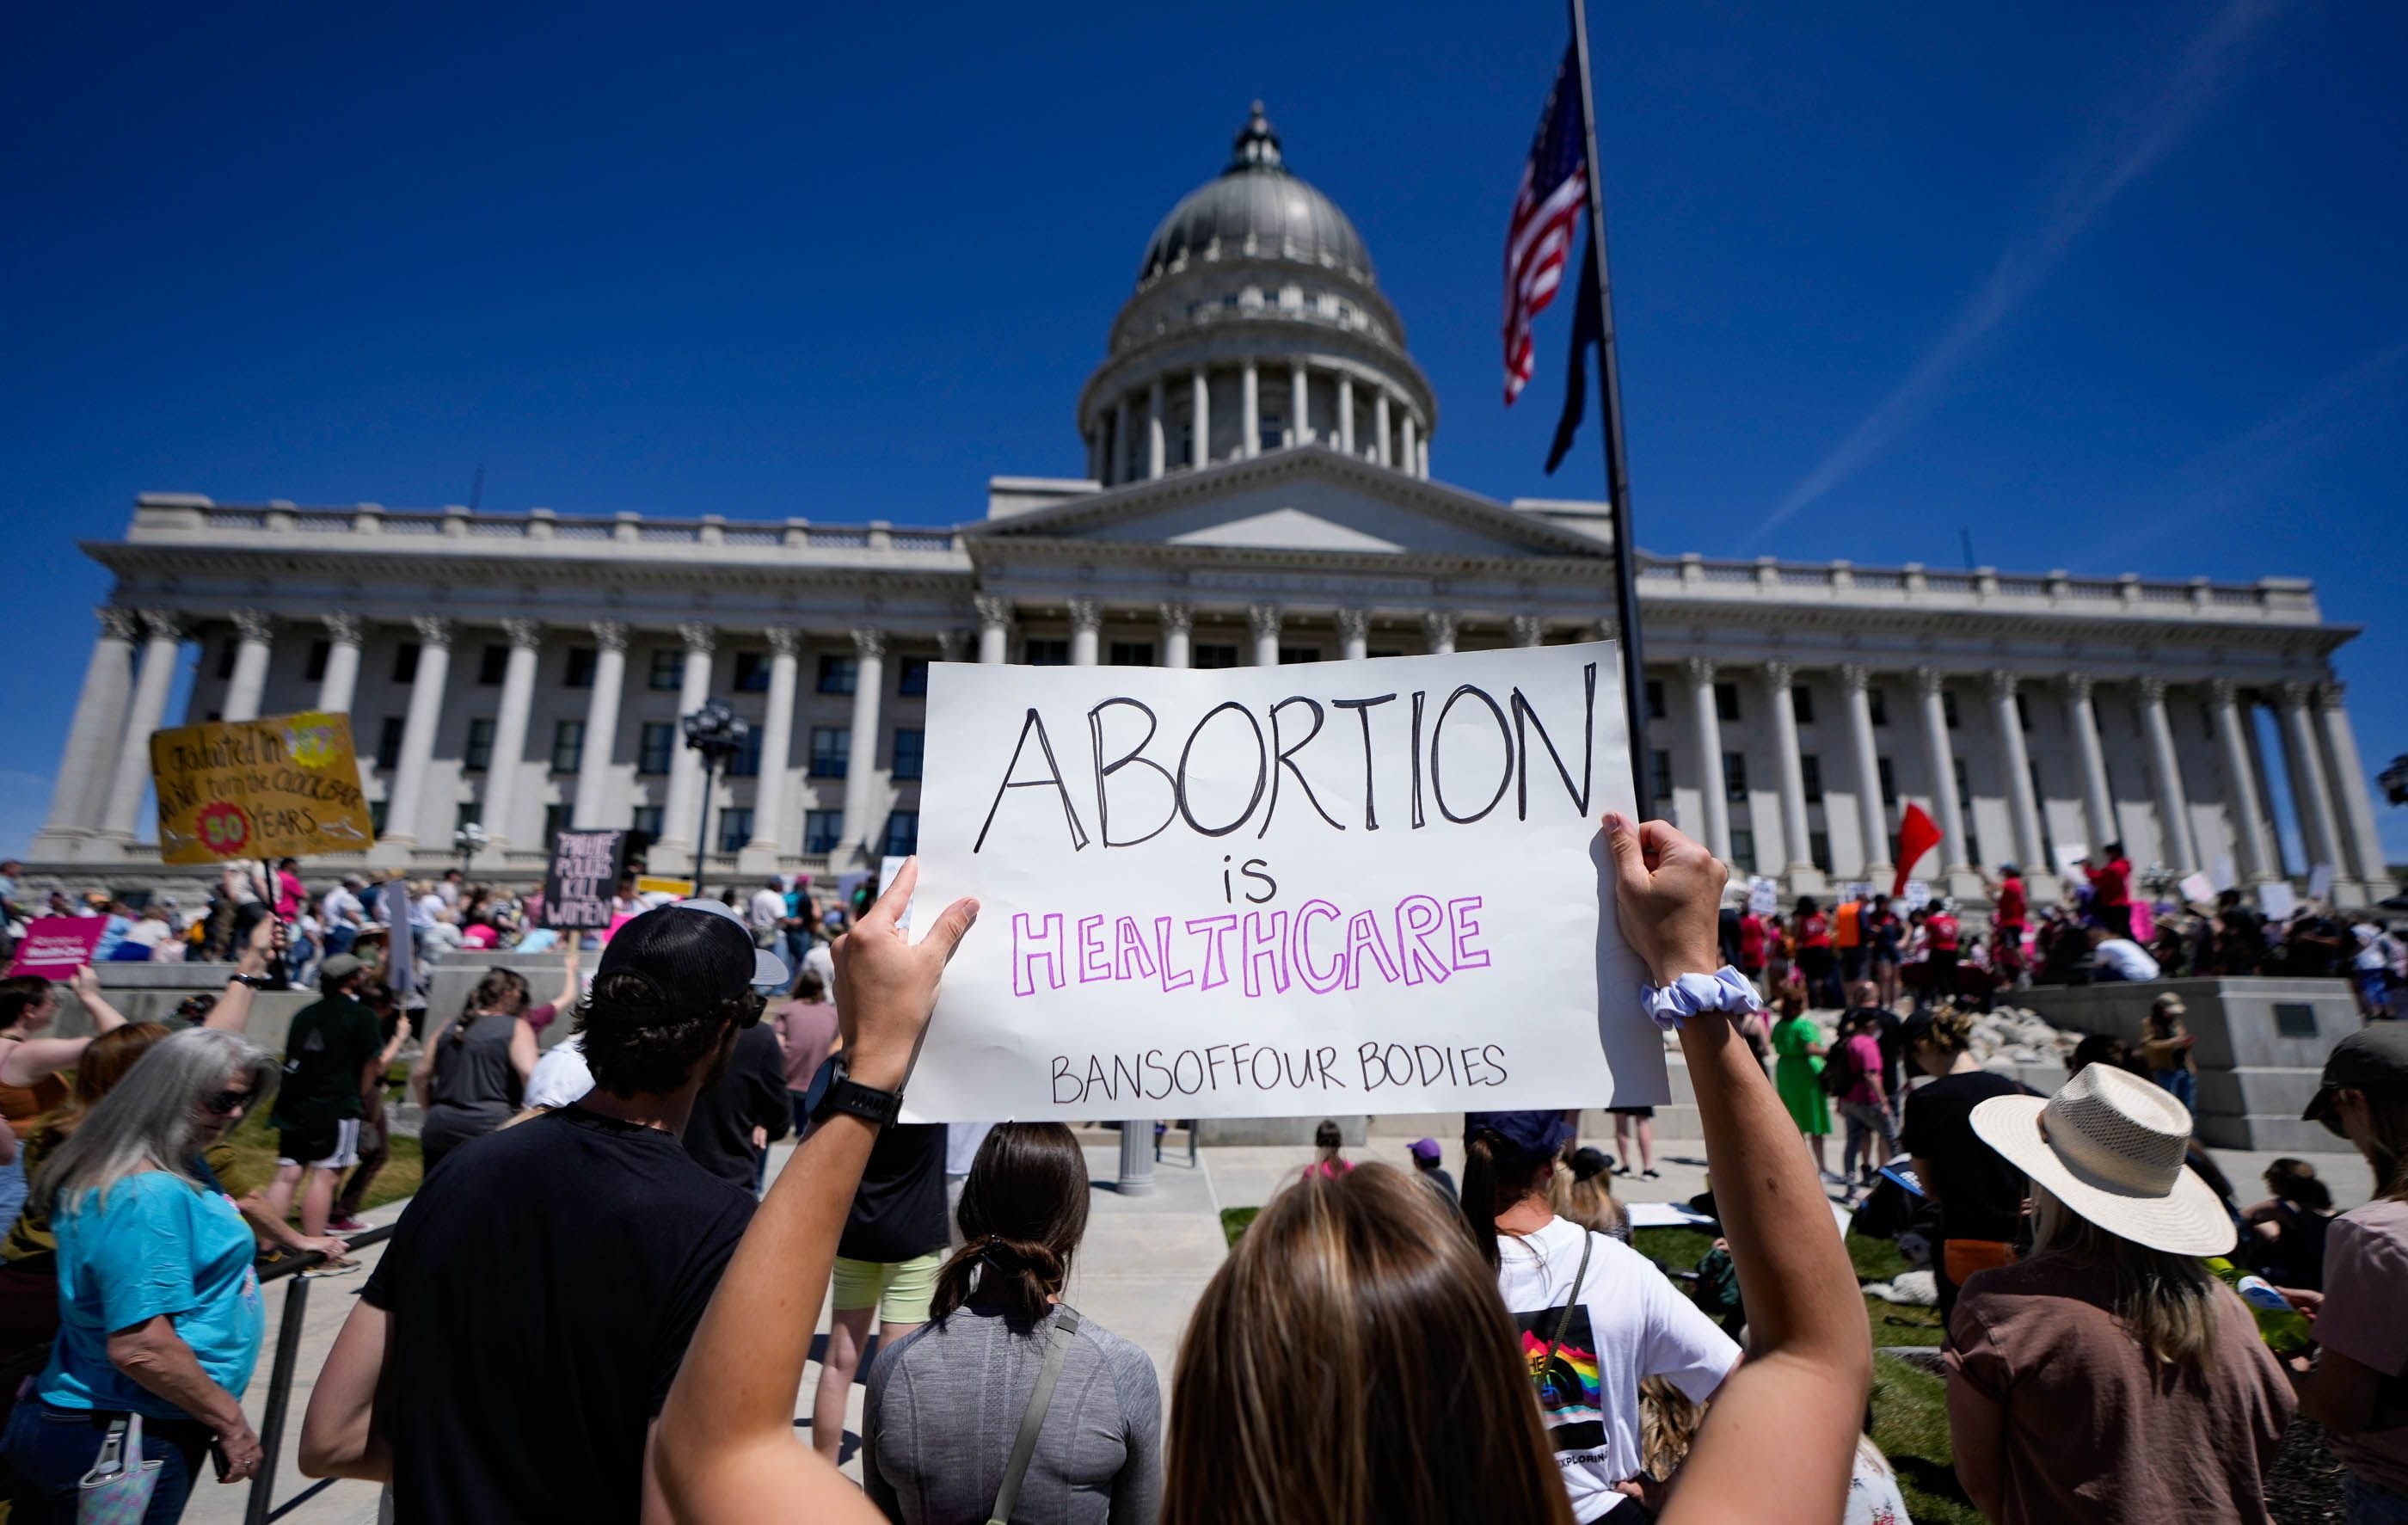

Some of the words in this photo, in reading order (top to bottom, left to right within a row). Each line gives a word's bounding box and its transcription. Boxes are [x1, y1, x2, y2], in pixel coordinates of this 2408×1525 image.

[973, 661, 1598, 854] ABORTION
[206, 815, 244, 845] 50
[246, 802, 318, 840] YEARS
[561, 877, 600, 901] KILL
[1224, 854, 1278, 905] is
[545, 898, 613, 927] WOMEN
[1012, 895, 1492, 998] HEALTHCARE
[1356, 1042, 1508, 1092] BODIES
